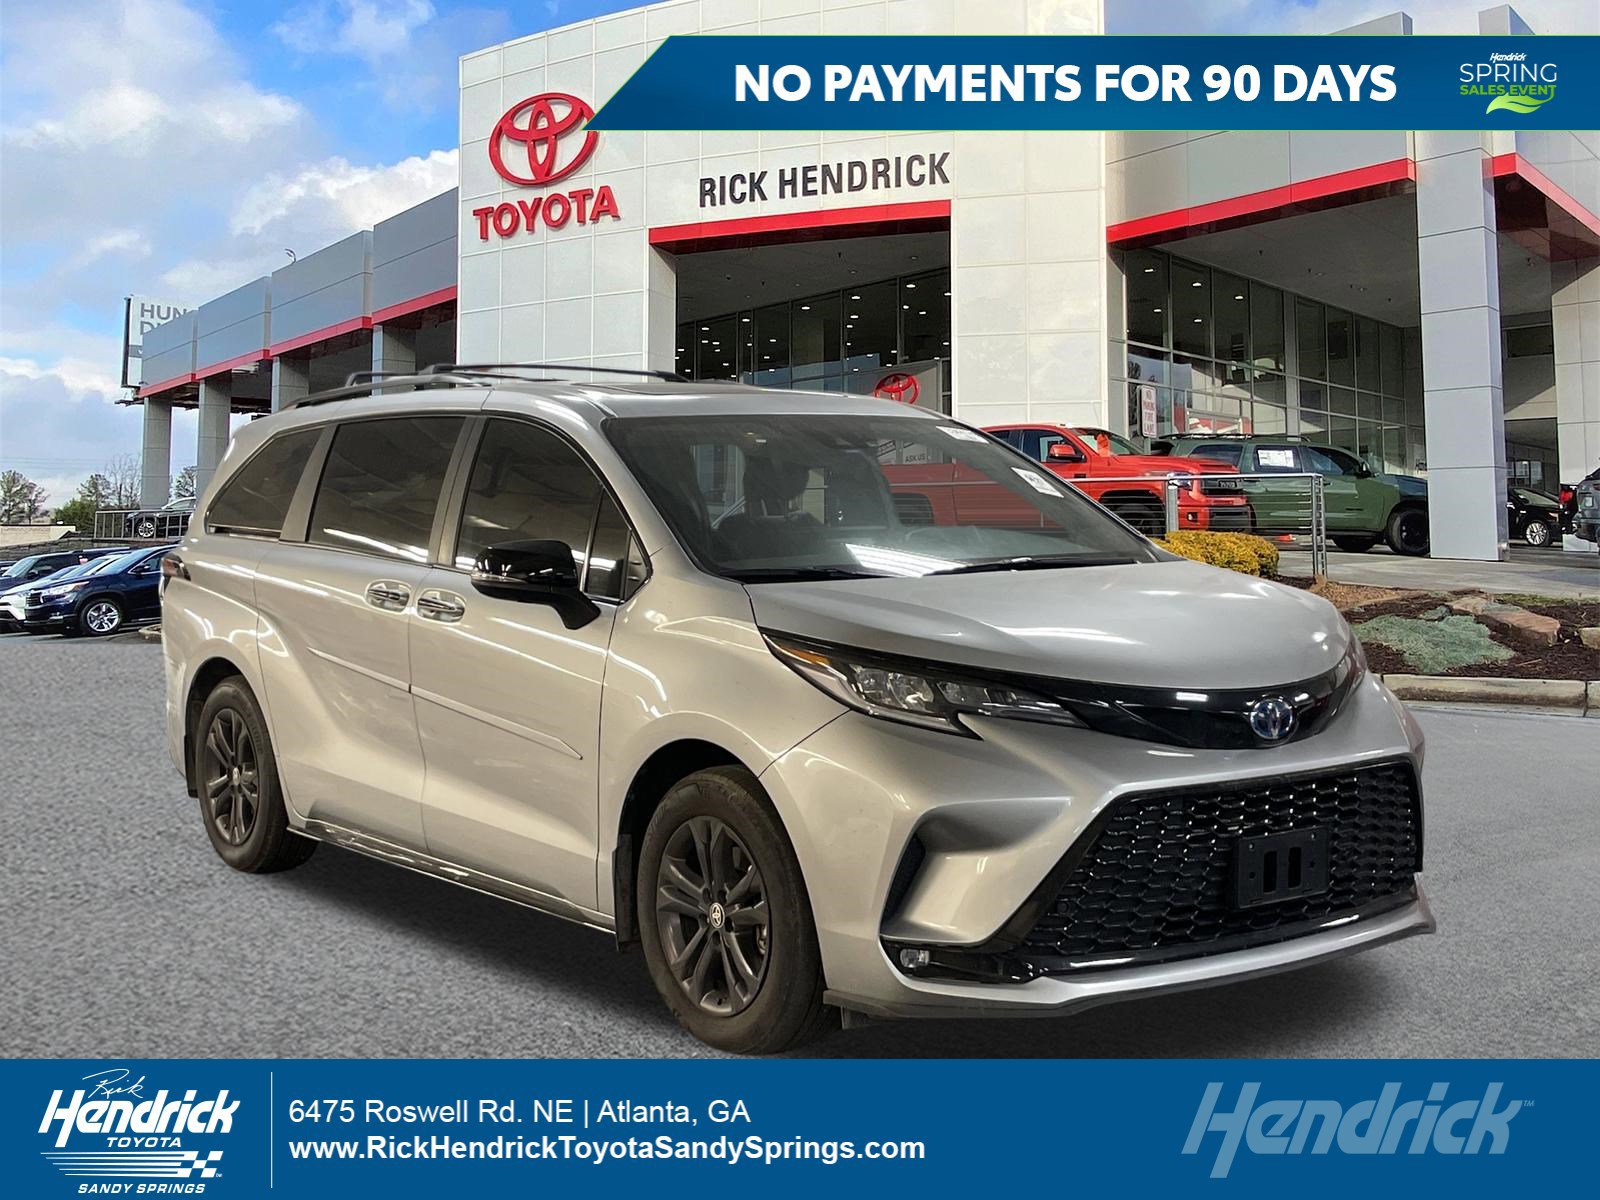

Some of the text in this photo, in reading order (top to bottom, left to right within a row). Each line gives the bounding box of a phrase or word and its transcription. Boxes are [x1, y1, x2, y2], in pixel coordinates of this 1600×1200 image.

[699, 152, 951, 208] RICK HENDRICK
[472, 185, 621, 241] TOYOTA
